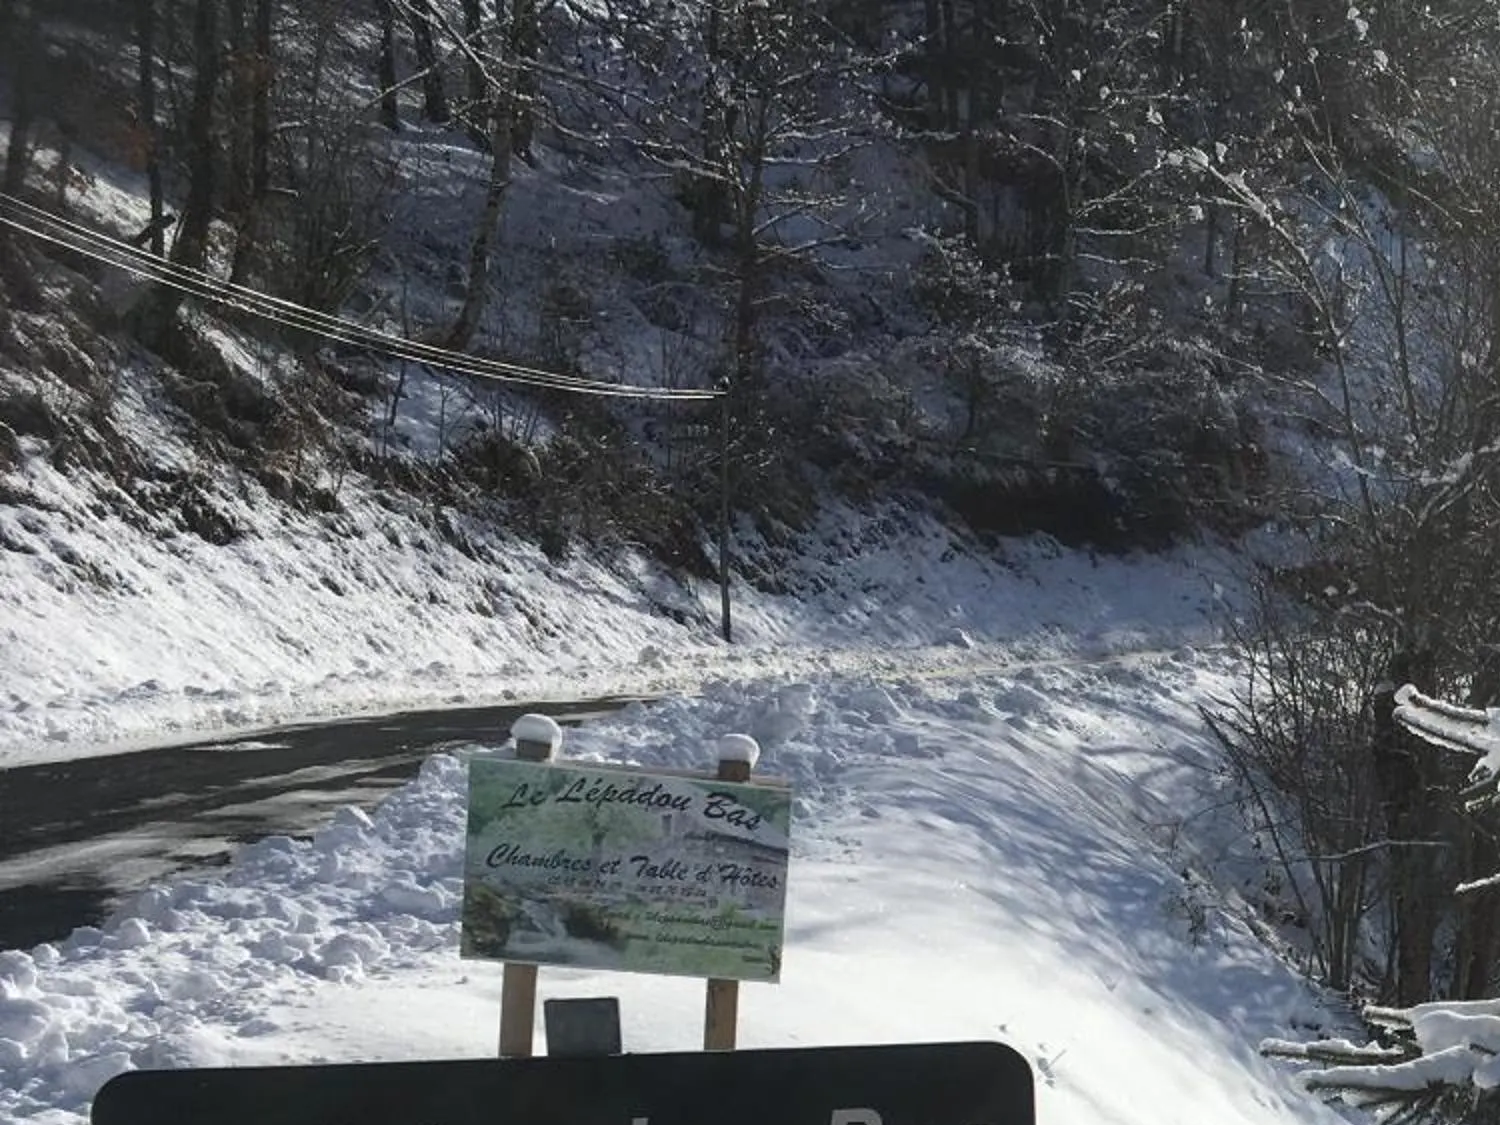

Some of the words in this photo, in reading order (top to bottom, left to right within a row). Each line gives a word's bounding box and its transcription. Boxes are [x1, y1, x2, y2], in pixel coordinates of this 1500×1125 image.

[501, 782, 548, 809] Le
[555, 776, 692, 812] Lépadou
[703, 791, 761, 831] Bas
[486, 843, 592, 869] Chambres
[600, 858, 622, 874] et
[630, 855, 688, 881] Table
